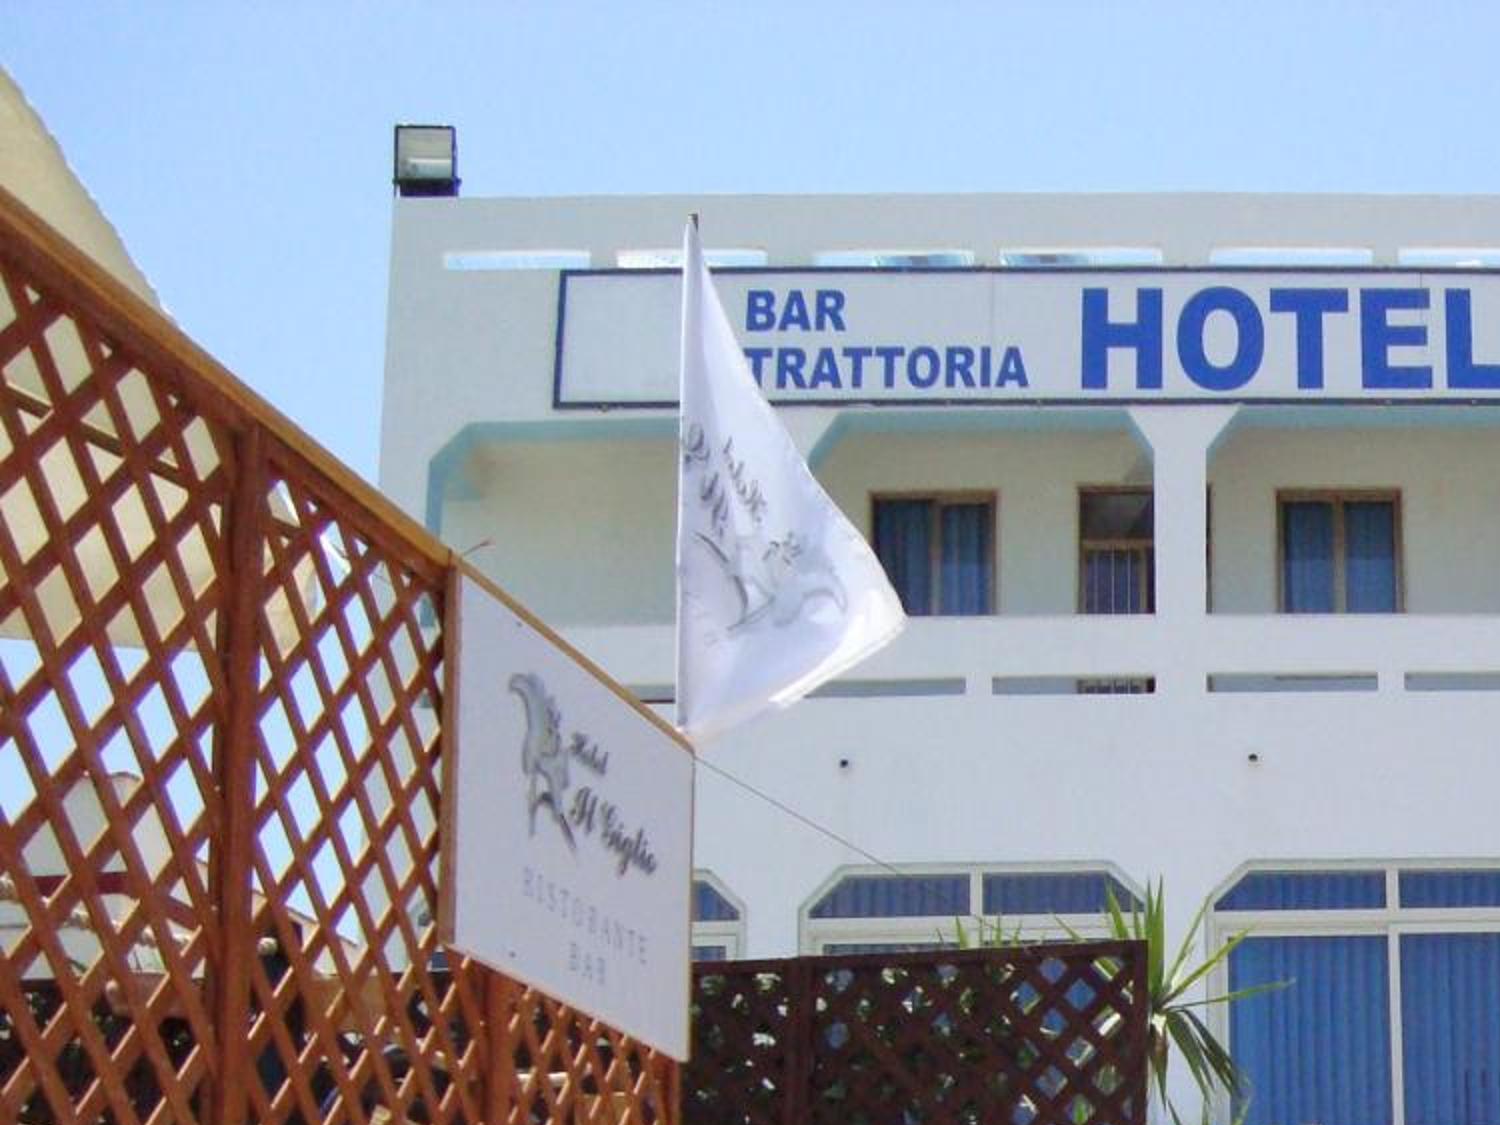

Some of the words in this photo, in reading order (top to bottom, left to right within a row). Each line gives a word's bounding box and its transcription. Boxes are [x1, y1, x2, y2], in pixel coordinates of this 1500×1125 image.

[745, 289, 845, 332] BAR
[743, 346, 1030, 389] TRATTORIA
[522, 865, 648, 966] RISTORANTE
[567, 940, 607, 988] BAR
